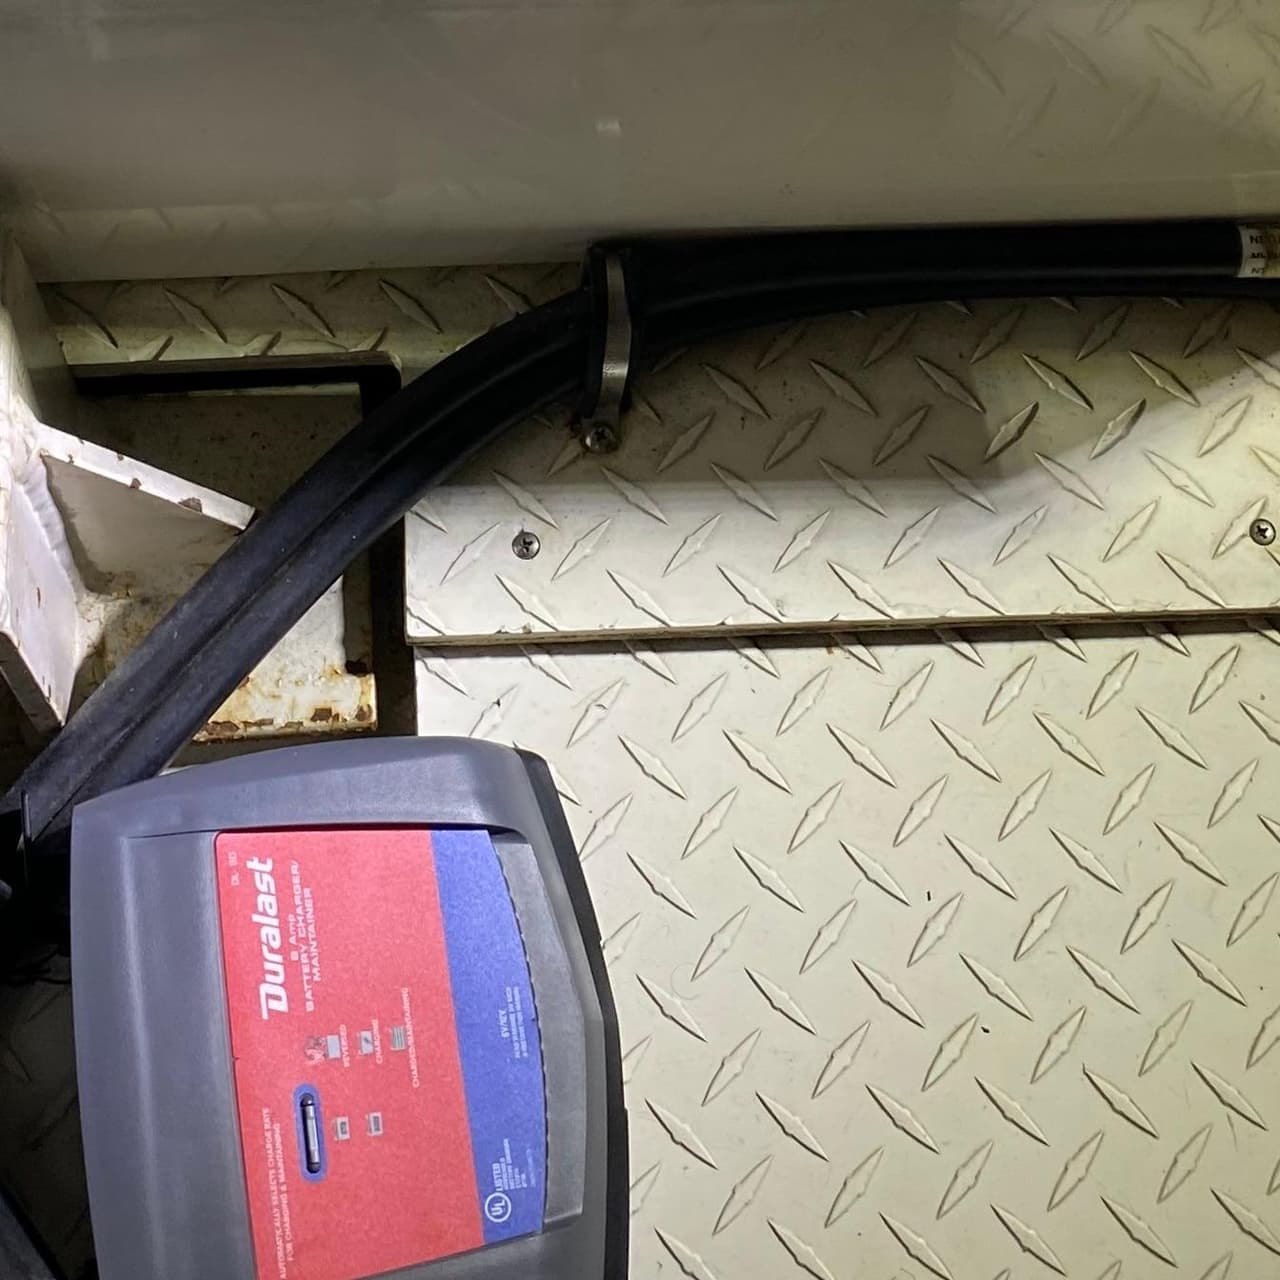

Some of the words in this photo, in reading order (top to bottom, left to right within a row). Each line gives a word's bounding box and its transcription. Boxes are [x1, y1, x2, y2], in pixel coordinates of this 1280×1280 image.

[245, 856, 289, 1019] Duralast
[286, 913, 298, 944] Amp
[303, 888, 321, 980] MAINTAINER
[299, 944, 314, 1010] BATTERY
[339, 1024, 350, 1067] REVERSED
[371, 1018, 383, 1063] CHARGING
[262, 1108, 271, 1128] RATE
[264, 1130, 275, 1166] CHARGE
[273, 1123, 285, 1181] MAINTAINING
[268, 1169, 279, 1204] SELECTS
[491, 1163, 503, 1190] LISTED
[280, 1193, 291, 1240] CHARGING
[489, 1199, 506, 1214] UL
[271, 1208, 287, 1279] AUTOMATICALLY
